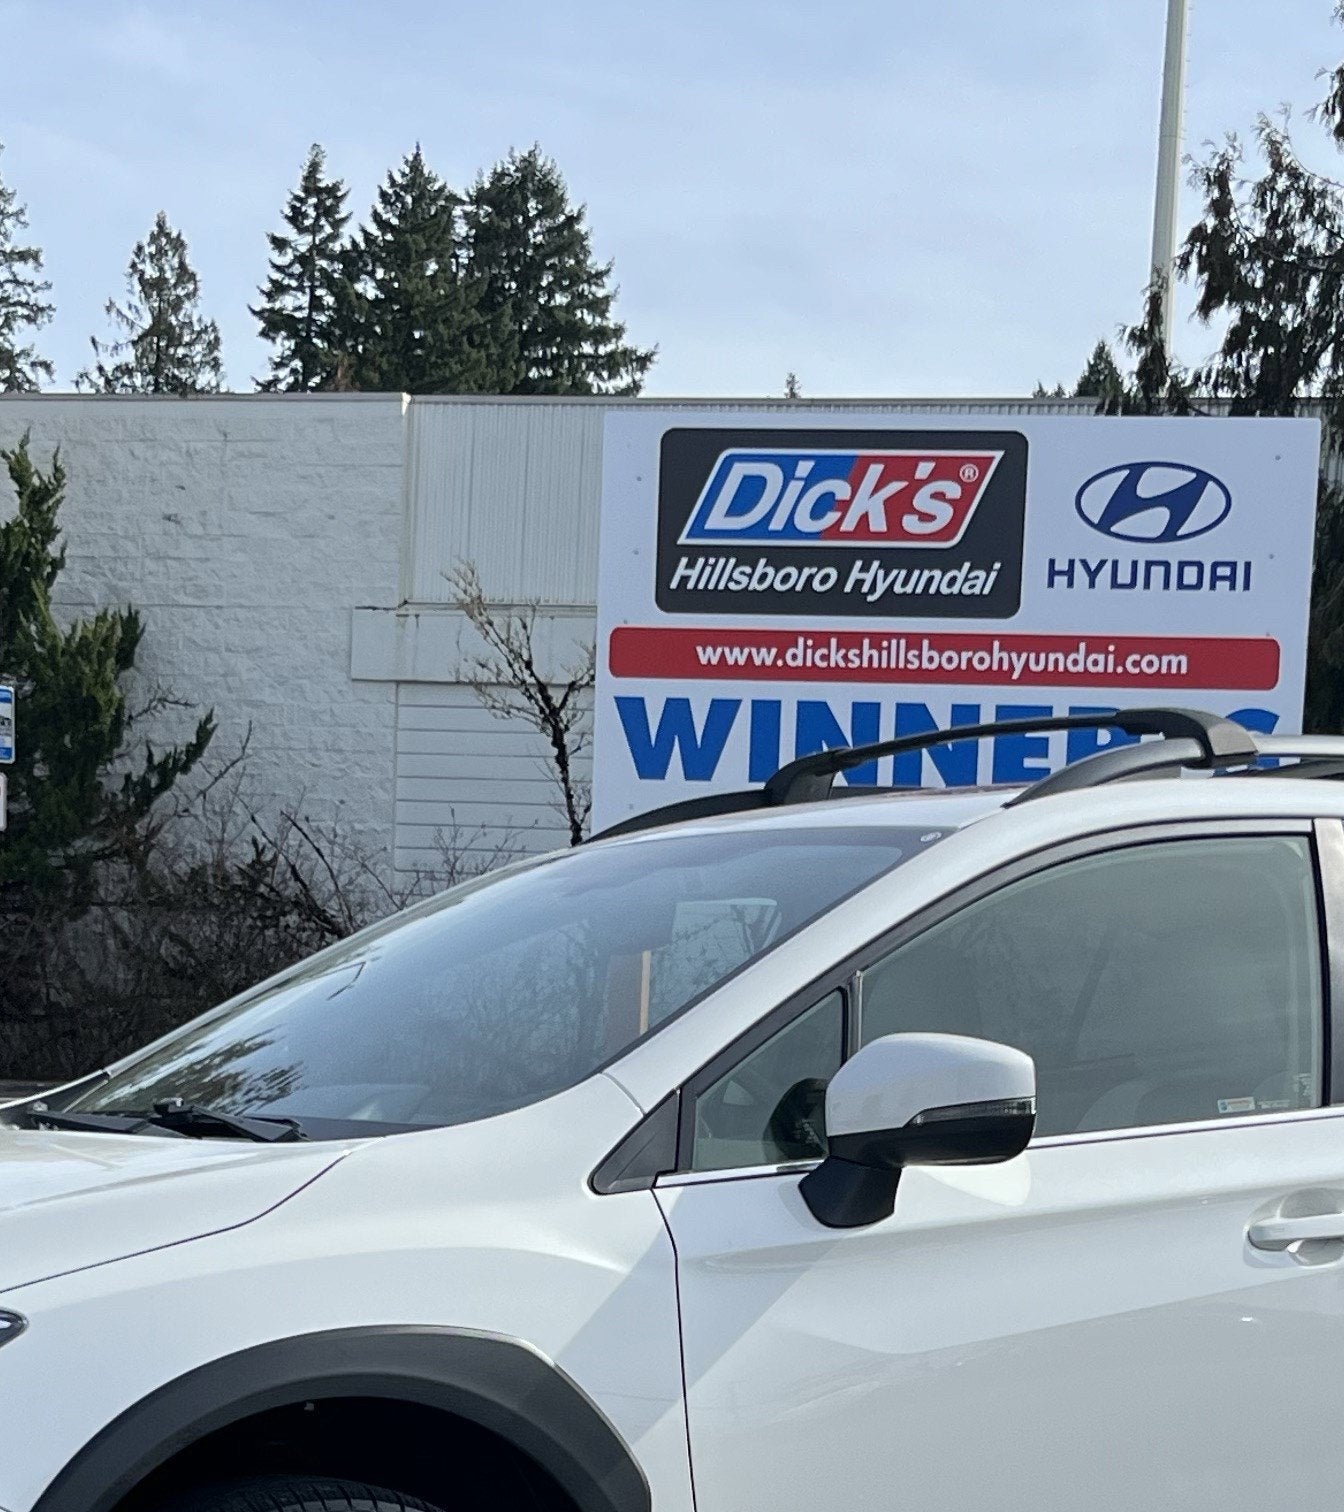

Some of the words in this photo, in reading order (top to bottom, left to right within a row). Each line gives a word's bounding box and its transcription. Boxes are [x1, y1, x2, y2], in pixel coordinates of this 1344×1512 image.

[669, 556, 839, 592] Hillsboro
[844, 560, 1002, 602] Hyundai
[1047, 558, 1253, 592] HYUNDAI
[696, 637, 1189, 680] www.dickshillsborohyundai.com
